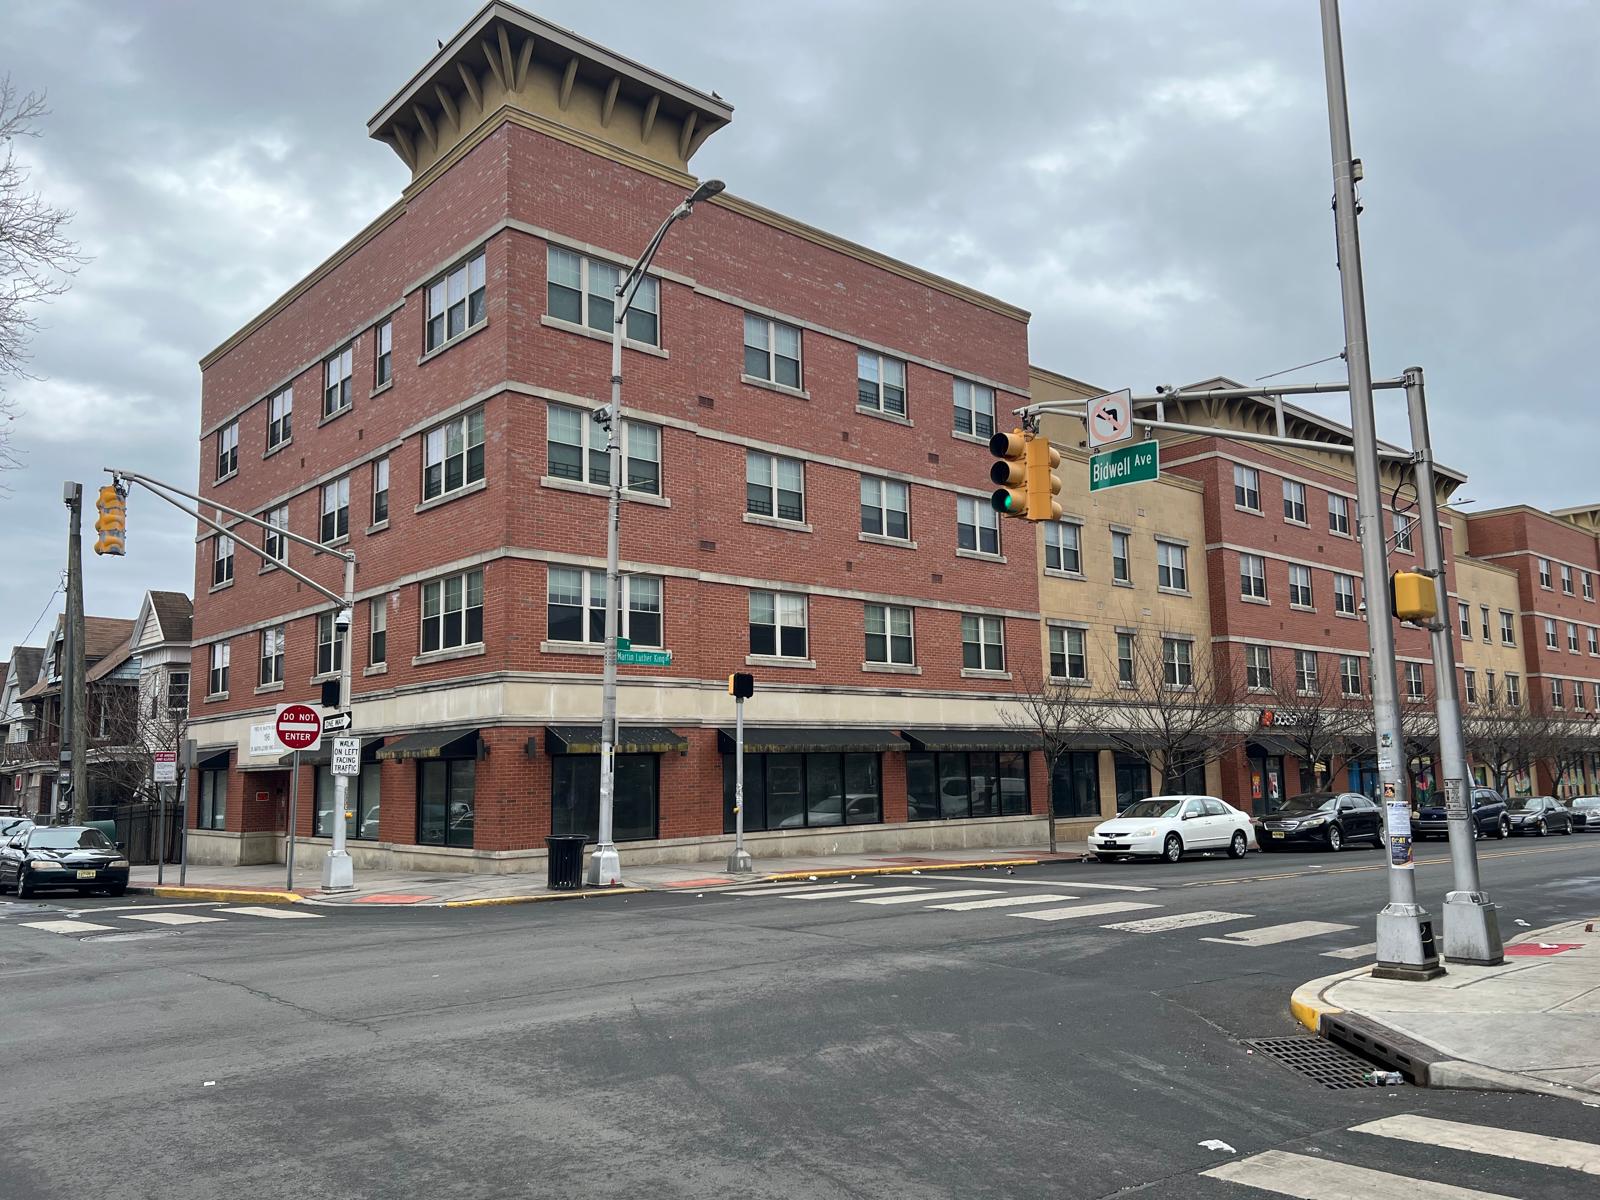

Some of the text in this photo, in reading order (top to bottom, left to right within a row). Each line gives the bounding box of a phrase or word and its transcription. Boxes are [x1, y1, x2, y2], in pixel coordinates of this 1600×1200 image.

[1093, 453, 1152, 483] Bidwell Ave
[617, 651, 634, 661] Martin
[635, 653, 652, 662] Luther
[653, 654, 665, 666] King
[283, 713, 315, 721] DO NOT
[325, 718, 344, 729] ONE WAY
[285, 732, 311, 741] ENTER
[334, 748, 358, 756] ON LEFT
